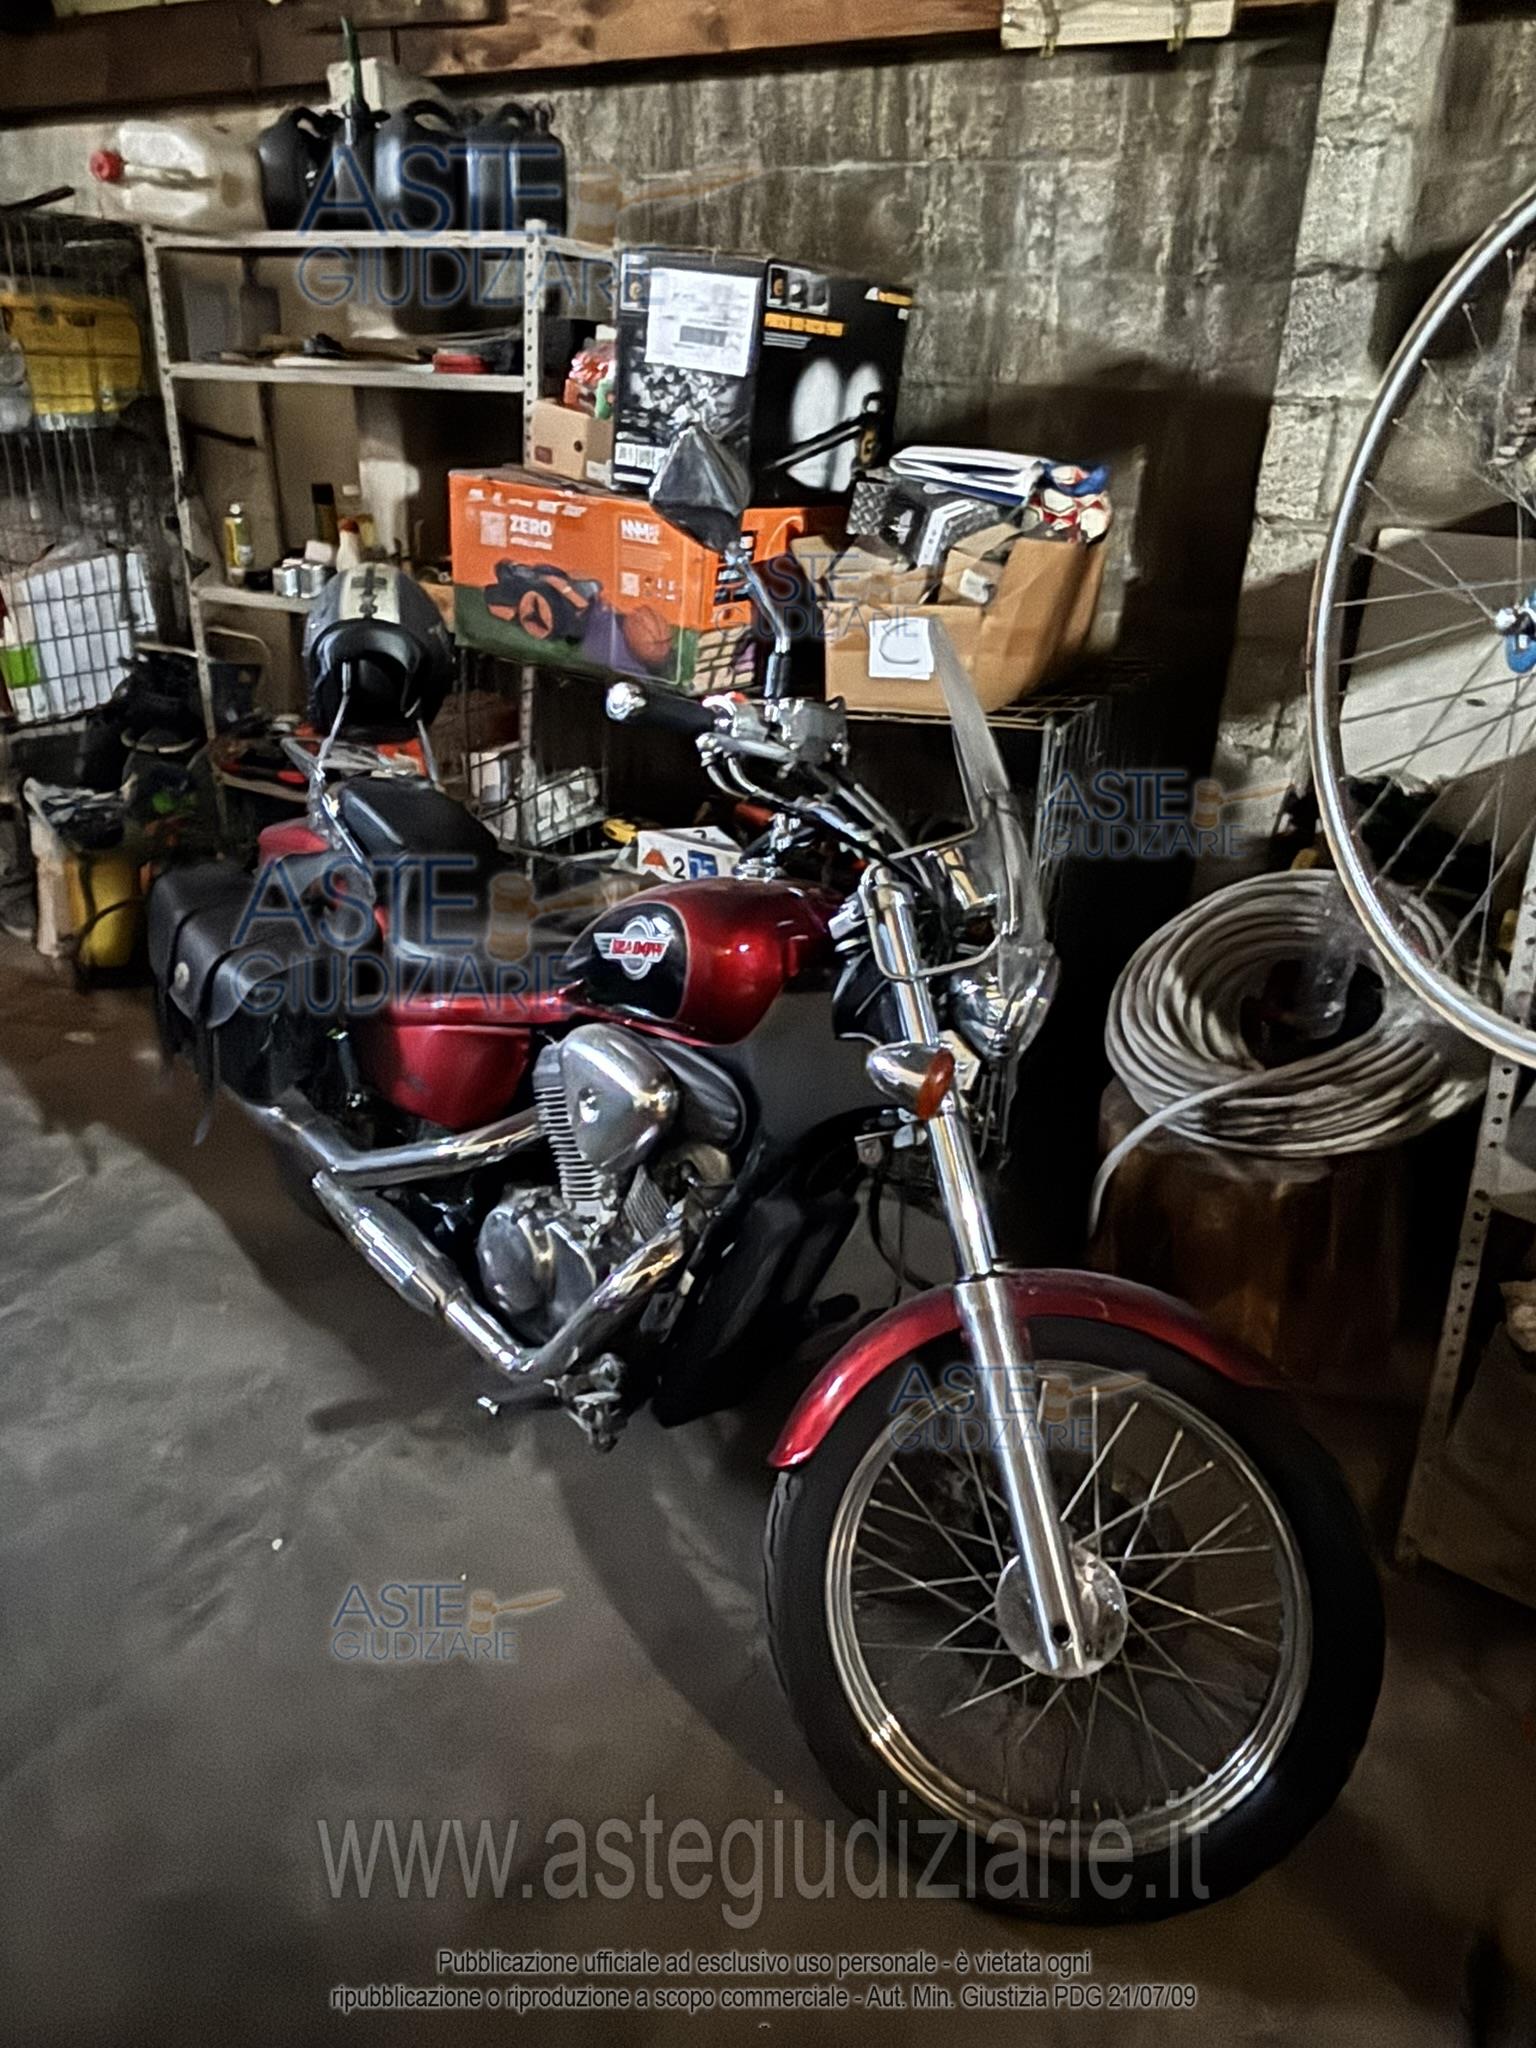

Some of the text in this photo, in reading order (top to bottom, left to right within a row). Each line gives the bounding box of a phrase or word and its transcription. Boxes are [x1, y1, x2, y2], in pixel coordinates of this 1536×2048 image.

[510, 514, 552, 537] ZERO
[879, 623, 920, 664] C
[673, 856, 686, 880] 2
